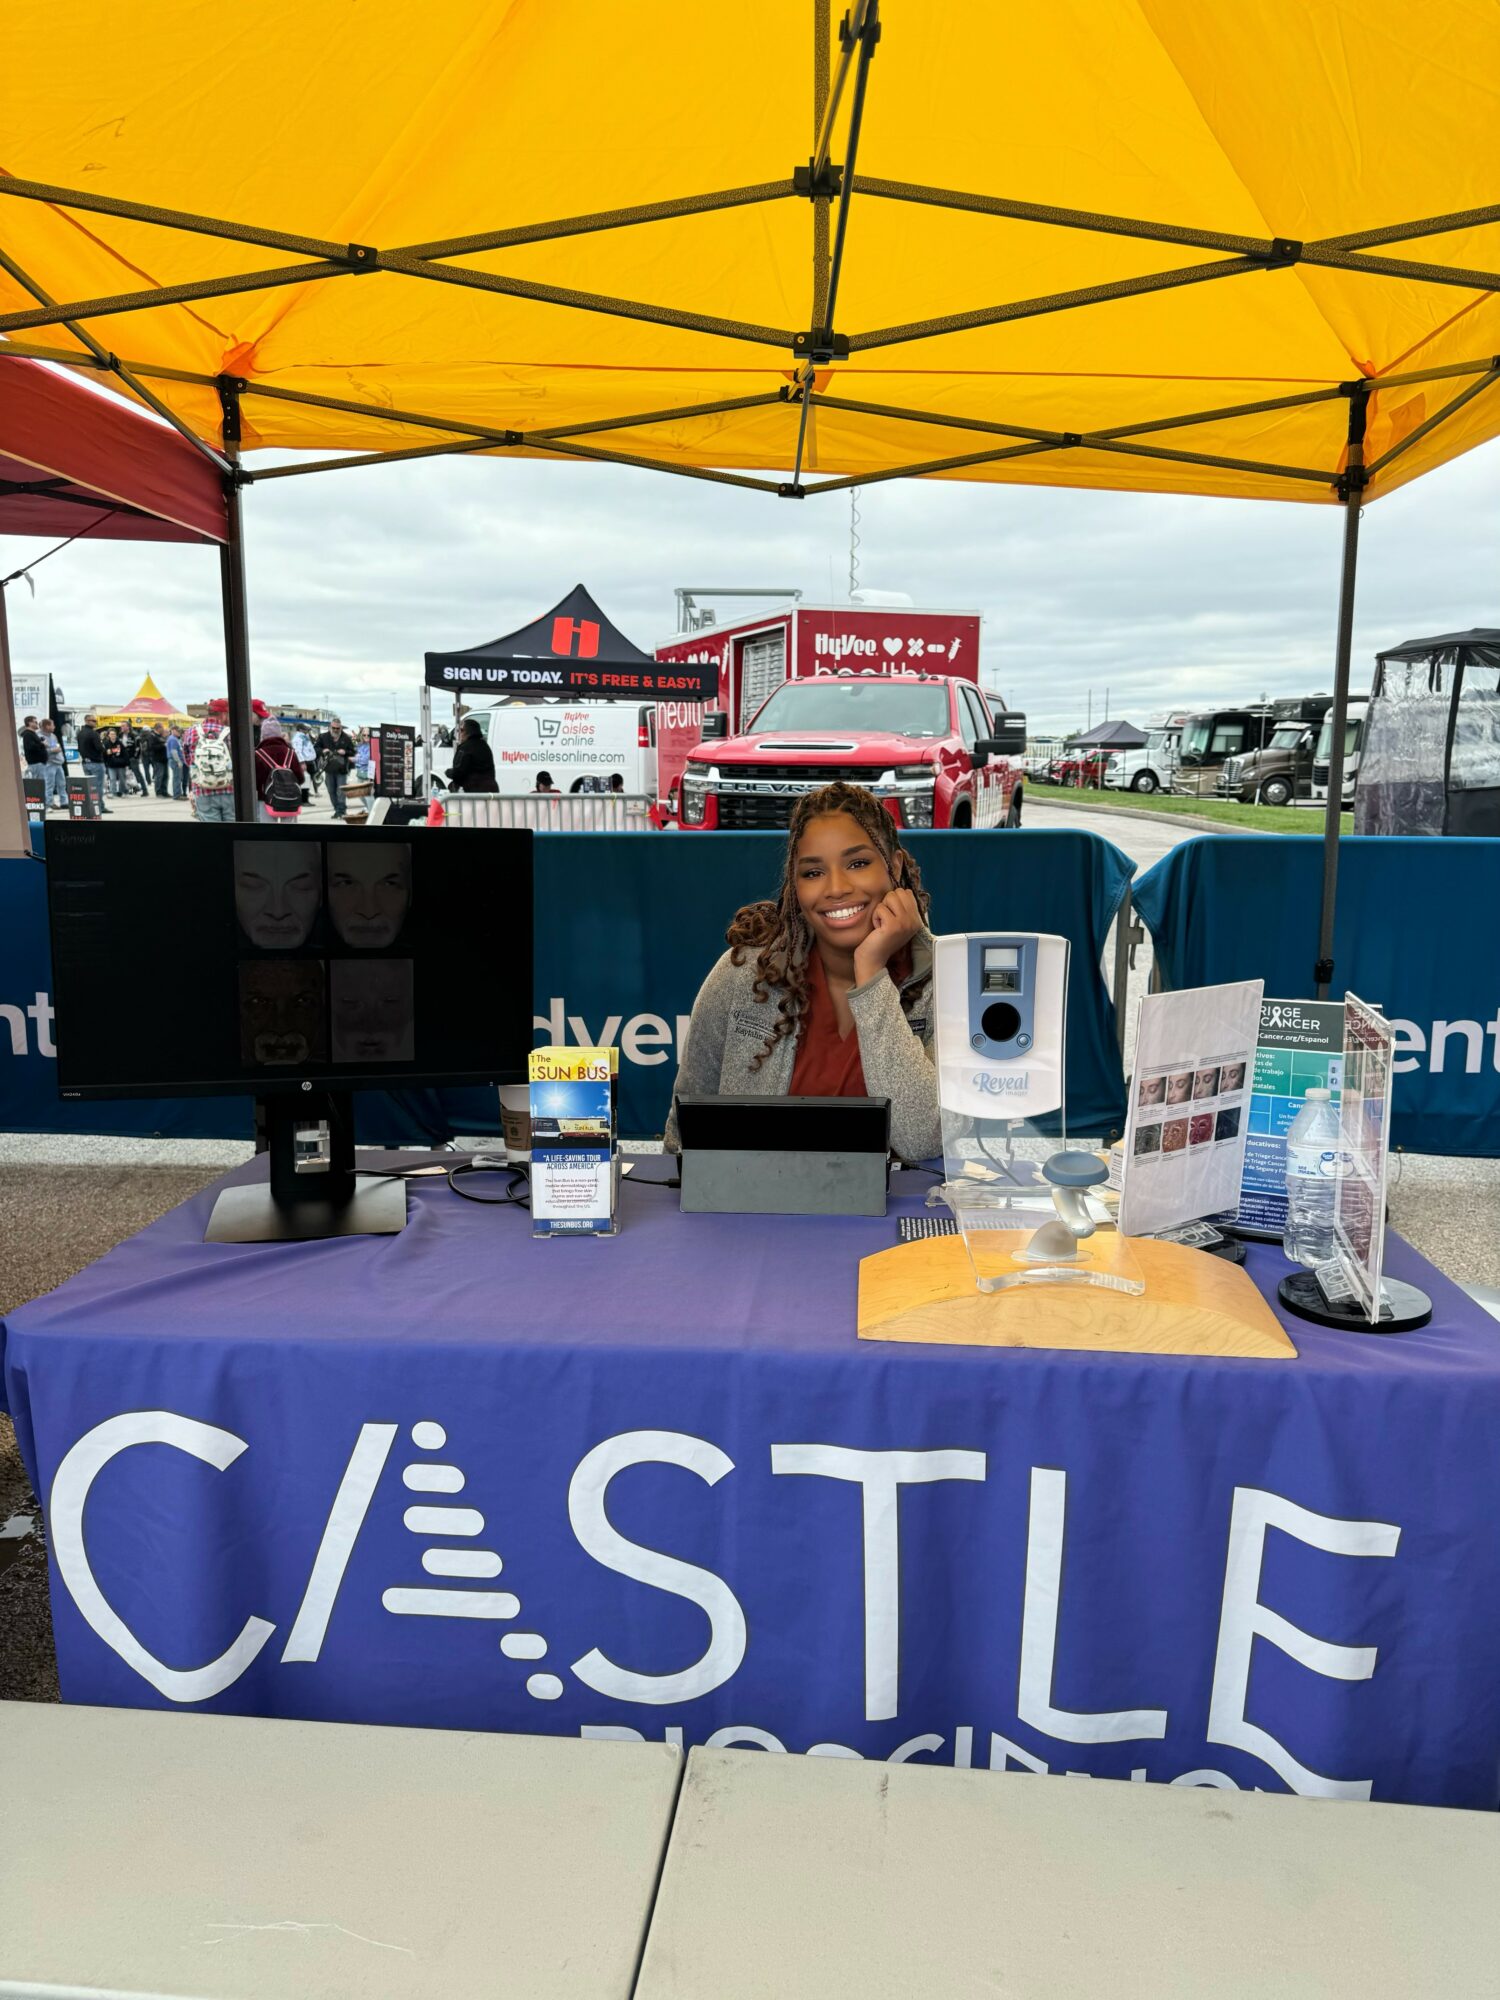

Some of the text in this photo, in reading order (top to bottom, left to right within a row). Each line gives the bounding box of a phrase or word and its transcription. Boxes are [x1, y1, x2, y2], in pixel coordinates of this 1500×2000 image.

[443, 667, 701, 689] SIGN UP TODAY. IT'S FREE & EASY!
[21, 692, 40, 706] GIFT
[562, 723, 595, 735] aisles
[386, 731, 398, 740] Daily
[561, 735, 594, 746] online
[537, 1054, 551, 1063] The
[537, 1066, 608, 1080] SUN BUS
[1262, 1068, 1284, 1077] trabajo
[972, 1071, 1029, 1096] Reveal
[547, 1162, 597, 1170] ACROSS AMERICA"
[550, 1220, 594, 1229] THESUNBUS.ORG
[48, 1410, 1402, 1800] CASTLE
